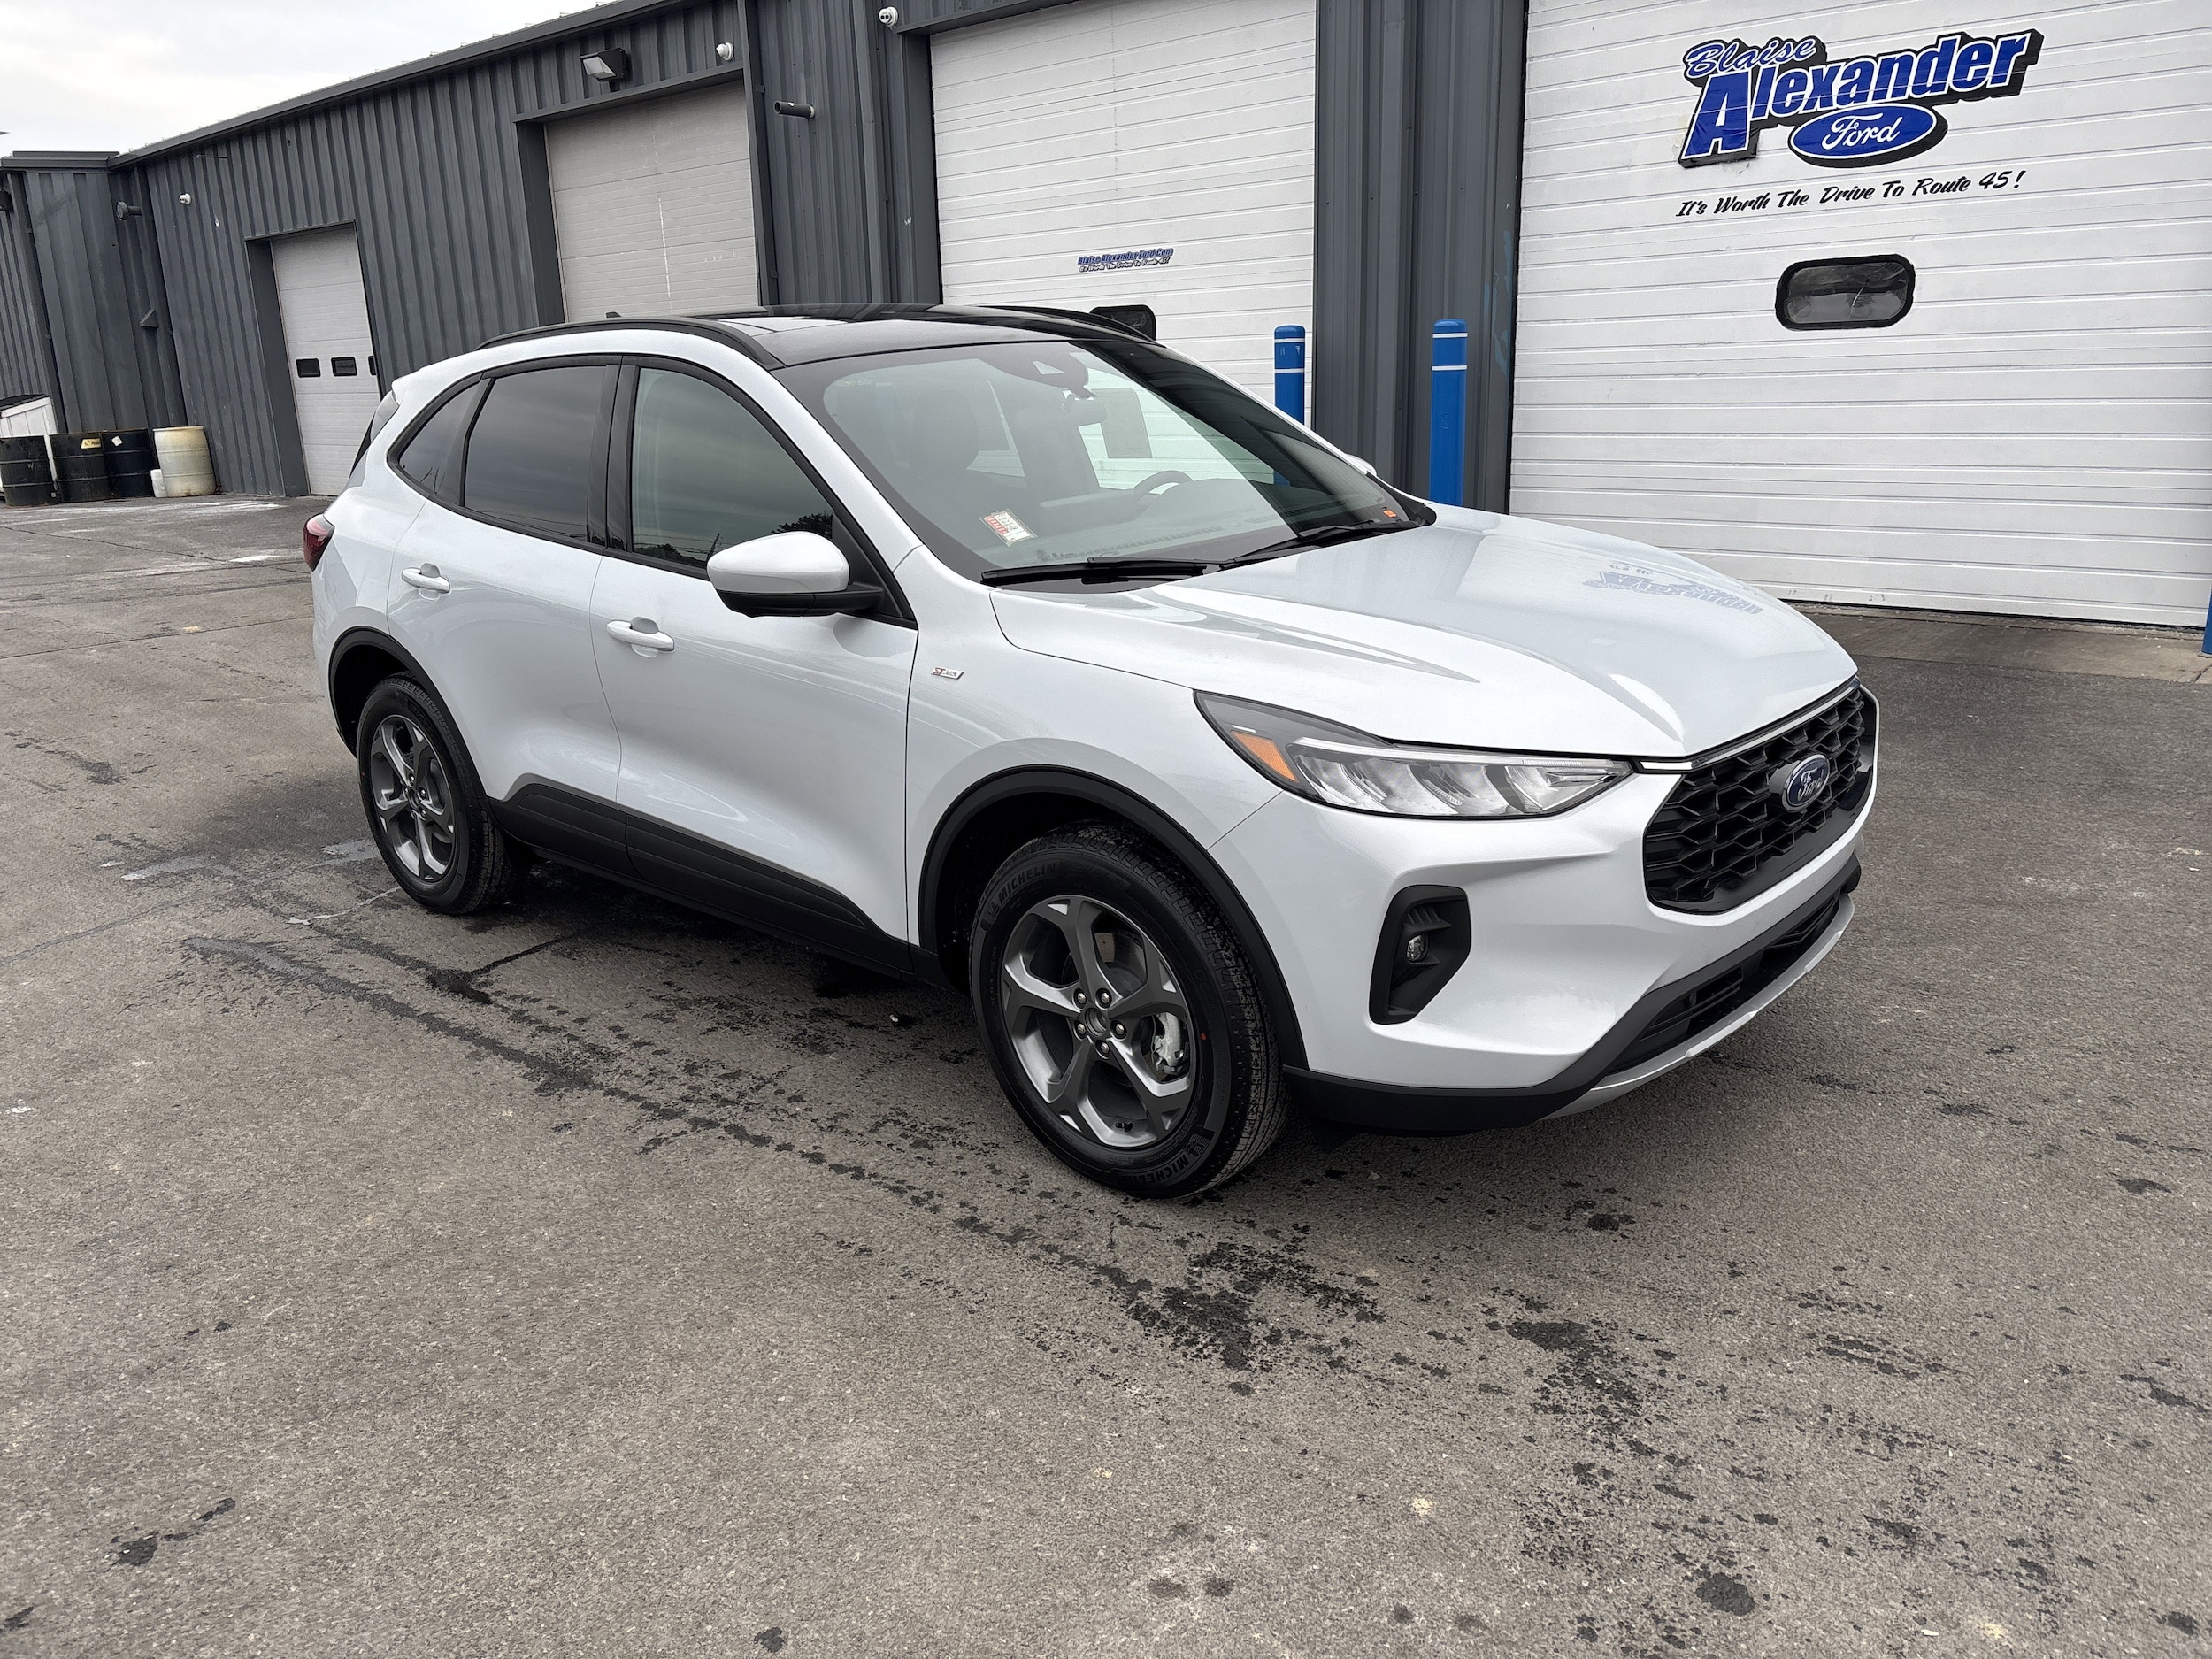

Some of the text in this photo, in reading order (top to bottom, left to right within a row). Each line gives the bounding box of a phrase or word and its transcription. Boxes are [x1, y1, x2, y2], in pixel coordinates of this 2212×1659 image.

[1686, 39, 1816, 77] Blaise
[1681, 33, 2032, 159] Alexander
[1821, 112, 1903, 150] Ford
[1675, 200, 1708, 217] It's
[1713, 192, 1770, 214] Worth
[1777, 189, 1810, 208] The
[1819, 186, 1876, 204] Drive
[1882, 180, 1906, 198] To
[1911, 176, 1972, 196] Route
[998, 862, 1060, 903] MICHELIN
